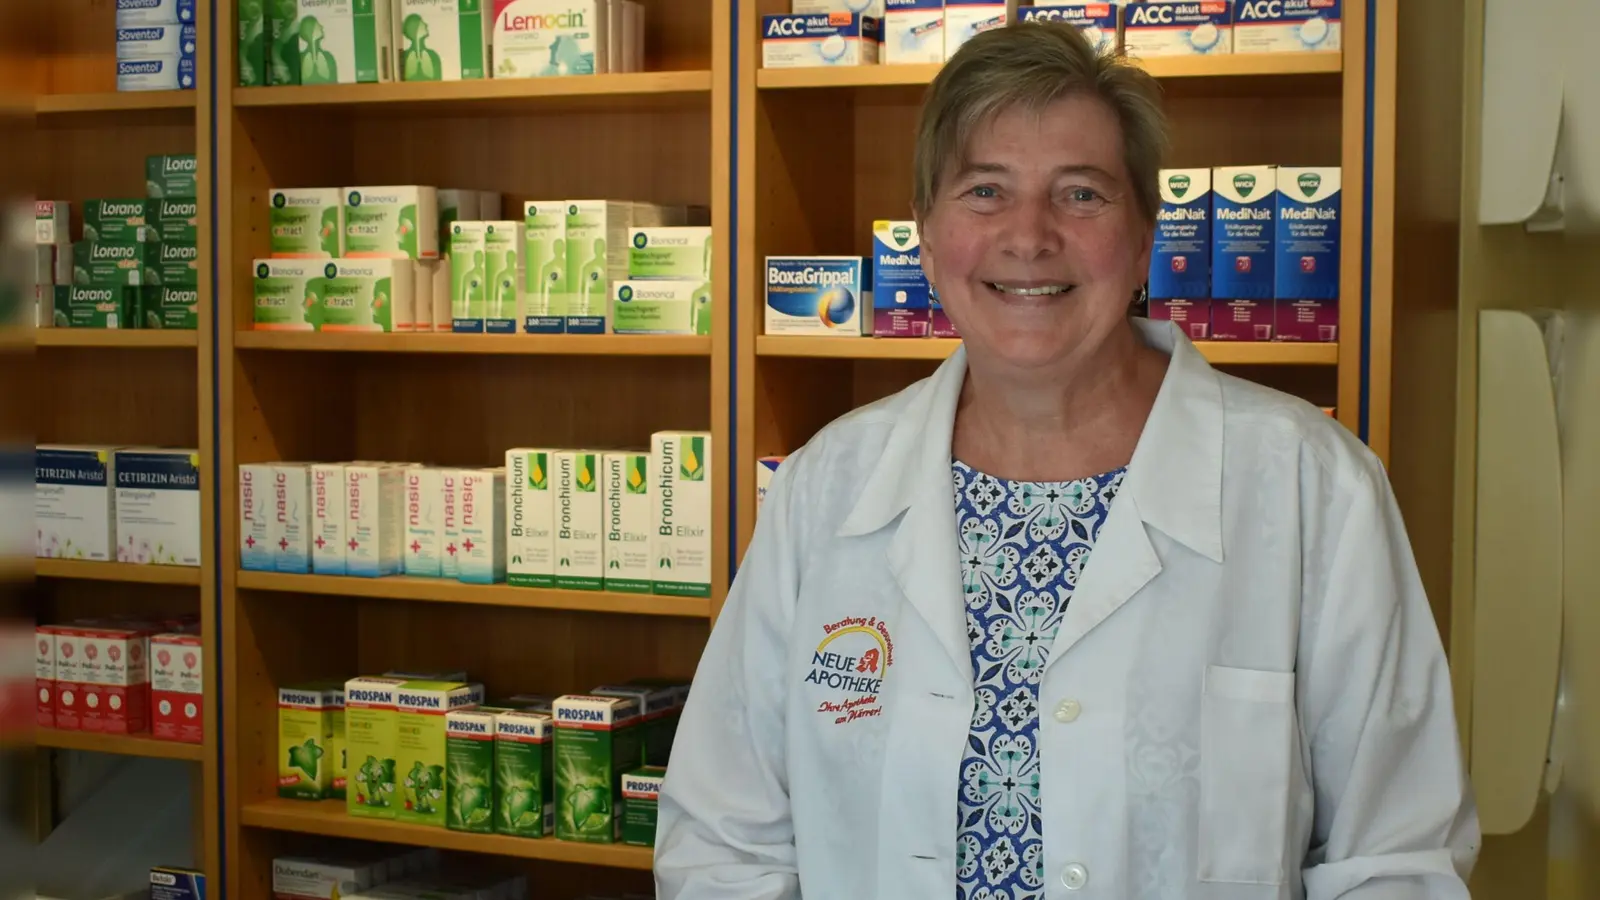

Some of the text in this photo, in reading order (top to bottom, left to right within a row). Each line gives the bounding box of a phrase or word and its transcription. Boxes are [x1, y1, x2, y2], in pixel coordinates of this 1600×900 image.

[1062, 9, 1085, 19] akut
[1131, 6, 1172, 24] ACC
[1175, 4, 1199, 14] akut
[1240, 1, 1281, 19] ACC
[504, 9, 584, 31] Lemocin
[767, 18, 805, 36] ACC
[806, 16, 829, 27] akut
[119, 29, 160, 40] Soventol
[120, 62, 159, 74] Soventol
[102, 202, 143, 215] Lorano
[163, 202, 196, 214] Loran
[1217, 208, 1271, 220] MediNait
[1281, 208, 1336, 220] MediNait
[274, 226, 302, 235] extract
[348, 225, 378, 234] extract
[651, 236, 688, 245] Bionorica
[93, 245, 135, 258] Lorano
[163, 246, 196, 258] Loran
[880, 255, 920, 265] MediNai
[769, 266, 854, 288] BoxaGrippal
[72, 288, 112, 301] Lorano
[164, 288, 197, 301] Loran
[636, 290, 675, 298] Bionorica
[257, 298, 285, 306] extract
[324, 298, 354, 307] extract
[35, 467, 103, 481] ETIRIZIN Aristo
[118, 472, 196, 484] CETIRIZIN Aristo
[660, 440, 673, 536] Bronchicum
[241, 472, 252, 521] nasic
[273, 473, 286, 522] nasic
[314, 471, 325, 519] nasic
[347, 472, 360, 520] nasic
[408, 476, 419, 525] nasic
[461, 477, 473, 525] nasic
[511, 456, 523, 537] Bronchicum
[559, 458, 571, 539] Bronchicum
[609, 460, 621, 541] Bronchicum
[441, 478, 454, 528] nasic
[526, 528, 549, 538] Elixir
[574, 530, 597, 540] Elixir
[624, 532, 647, 542] Elixir
[677, 526, 704, 537] Elixir
[823, 616, 867, 634] Beratung
[868, 617, 876, 626] &
[812, 651, 856, 672] NEUE
[805, 668, 882, 693] APOTHEKE
[282, 693, 315, 704] PROSPAN
[349, 690, 392, 702] PROSPAN
[398, 694, 440, 707] PROSPAN
[817, 694, 876, 712] Ihre Apotheke
[558, 708, 603, 721] PROSPAN
[448, 720, 486, 732] PROSPAN
[499, 722, 535, 735] PROSPAN
[627, 781, 661, 792] PROSPA
